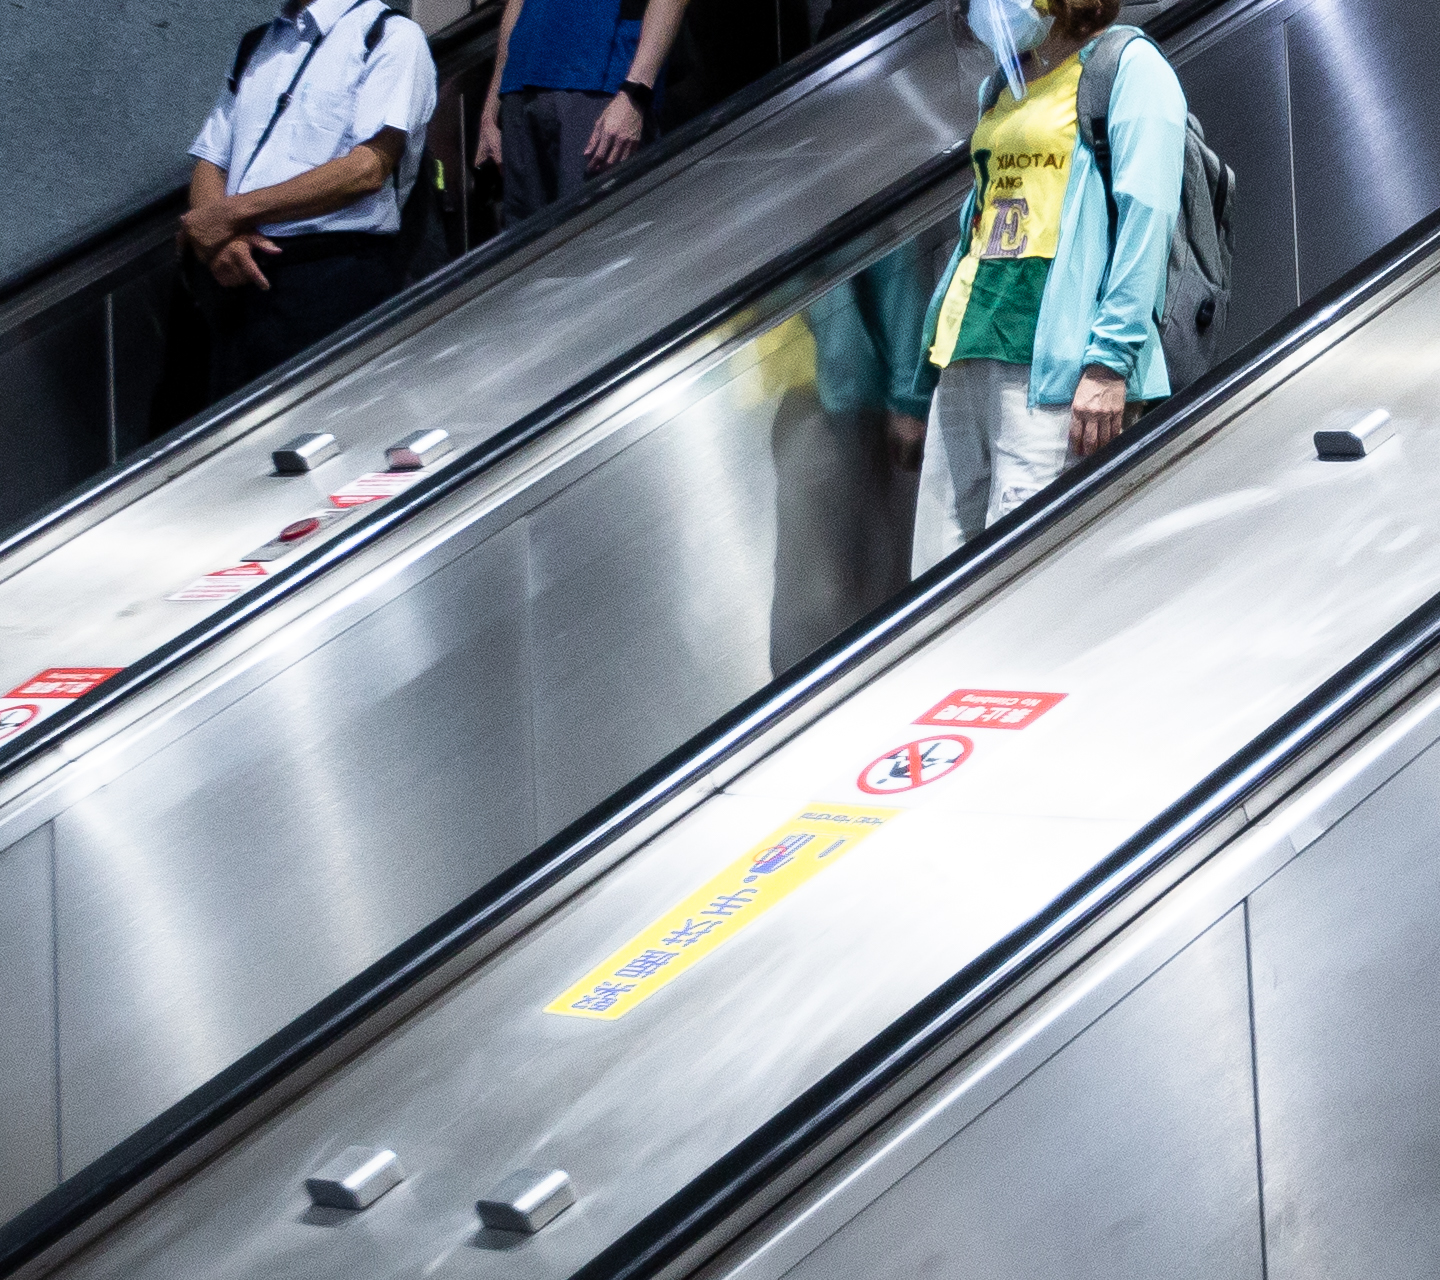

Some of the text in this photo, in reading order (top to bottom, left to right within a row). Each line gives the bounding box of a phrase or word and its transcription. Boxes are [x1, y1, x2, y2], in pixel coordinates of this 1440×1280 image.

[996, 153, 1066, 171] XIAOTAI
[570, 887, 758, 1012] 緊握扶手
